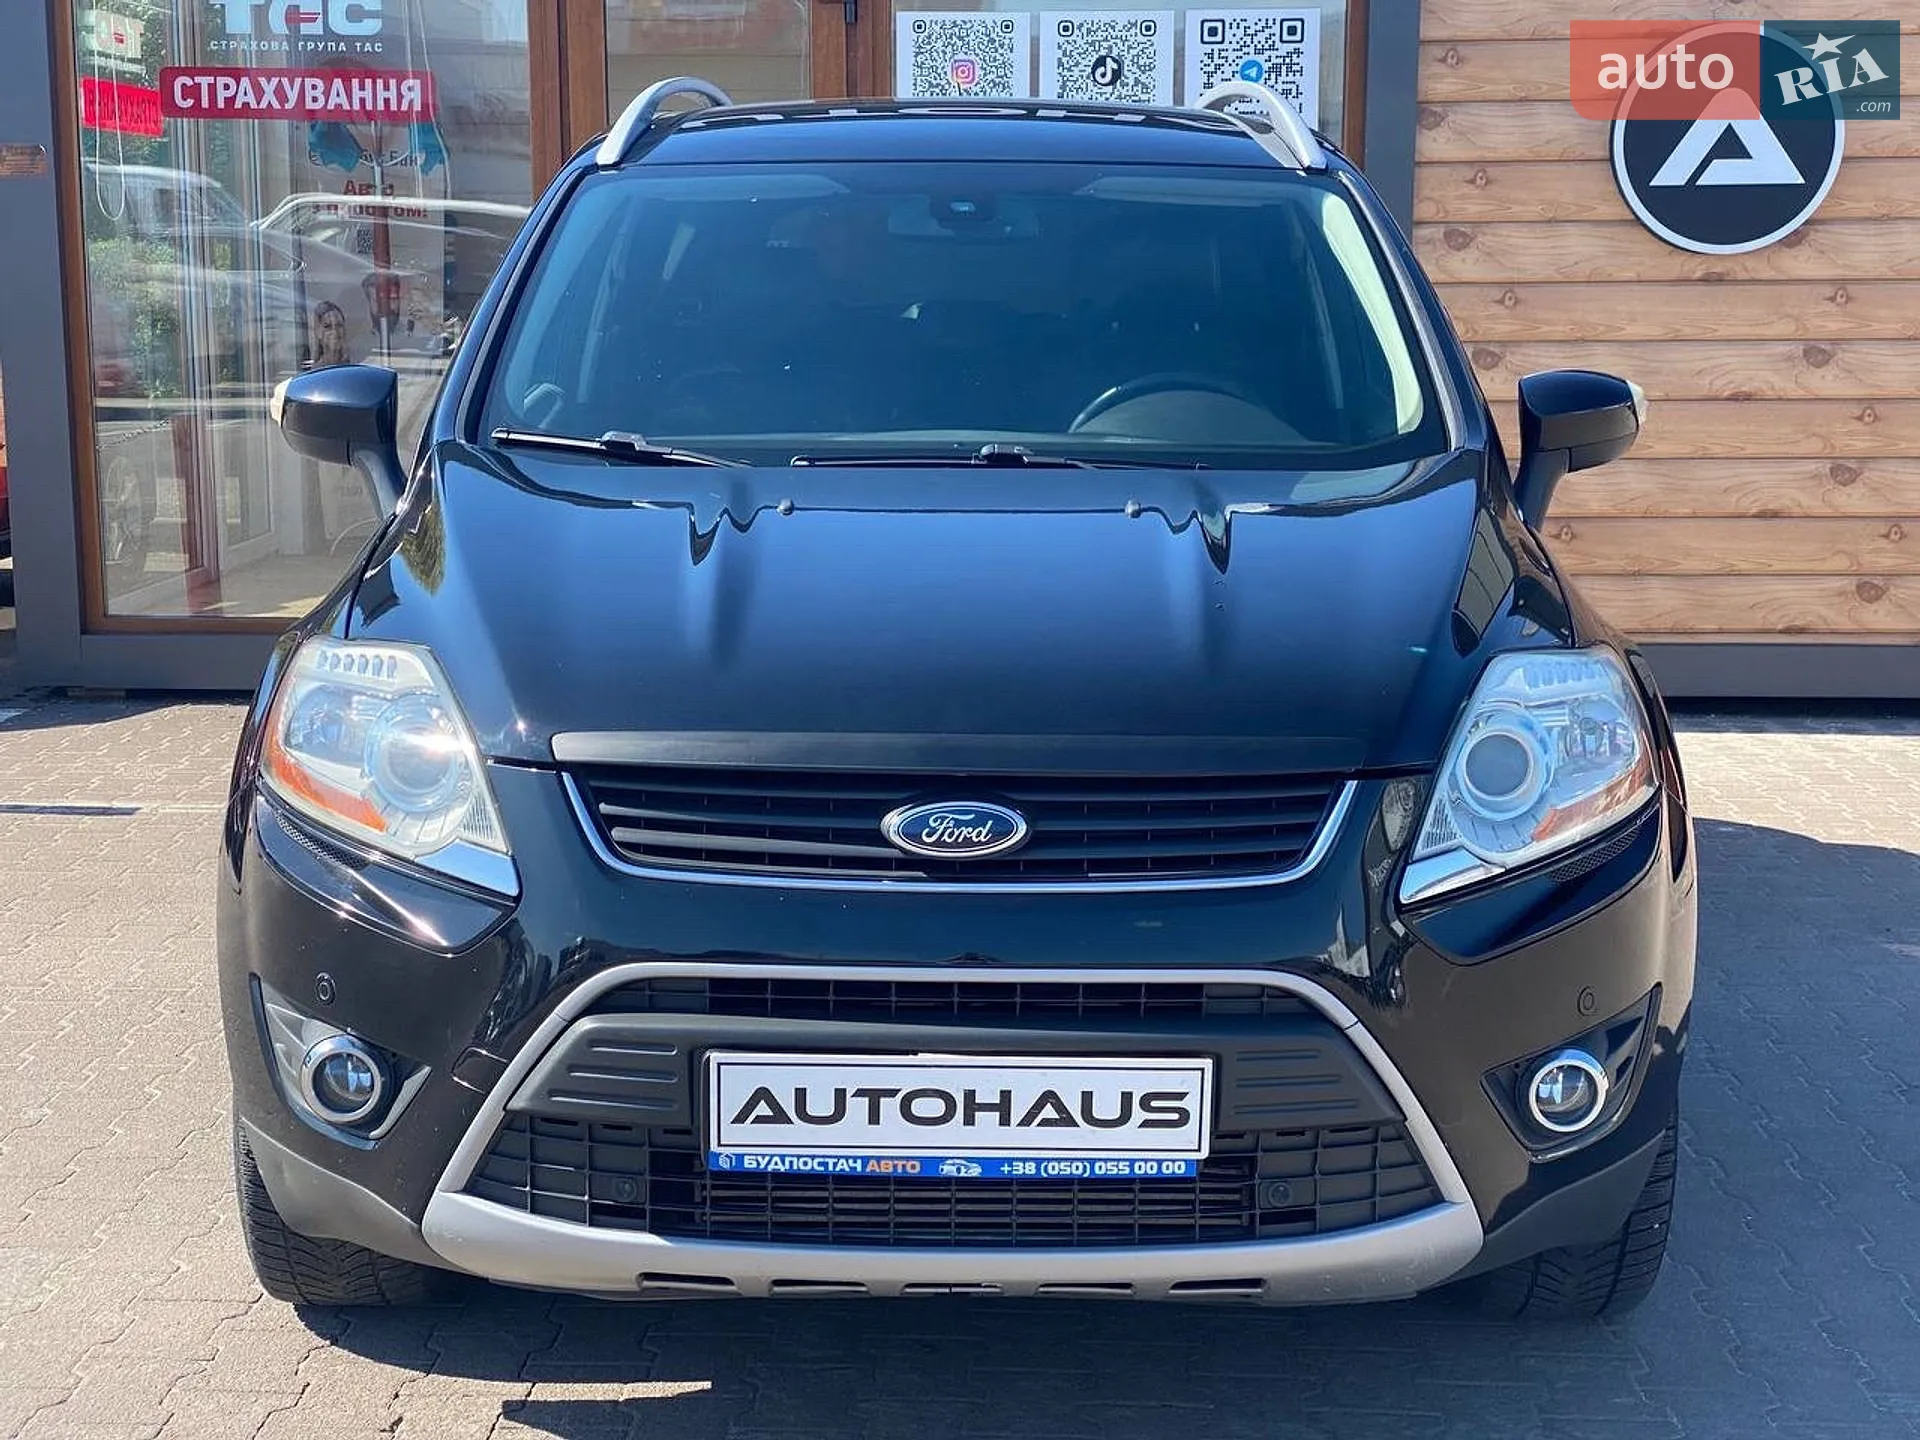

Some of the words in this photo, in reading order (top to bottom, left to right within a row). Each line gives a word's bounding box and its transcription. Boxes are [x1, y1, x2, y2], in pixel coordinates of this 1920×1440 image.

[209, 40, 290, 51] СТРАХОВА
[298, 41, 347, 52] ГРУПА
[355, 42, 384, 53] ТАС
[172, 75, 422, 112] СТРАХУВАННЯ
[921, 812, 994, 843] Ford
[729, 1086, 1192, 1129] AUTOHAUS
[743, 1155, 862, 1173] БУДПОСТАЧ
[866, 1159, 921, 1174] АВТО
[1000, 1161, 1036, 1176] +38
[1040, 1161, 1090, 1178] (050)
[1094, 1161, 1130, 1176] 055
[1134, 1161, 1158, 1175] 00
[1161, 1161, 1186, 1175] 00
